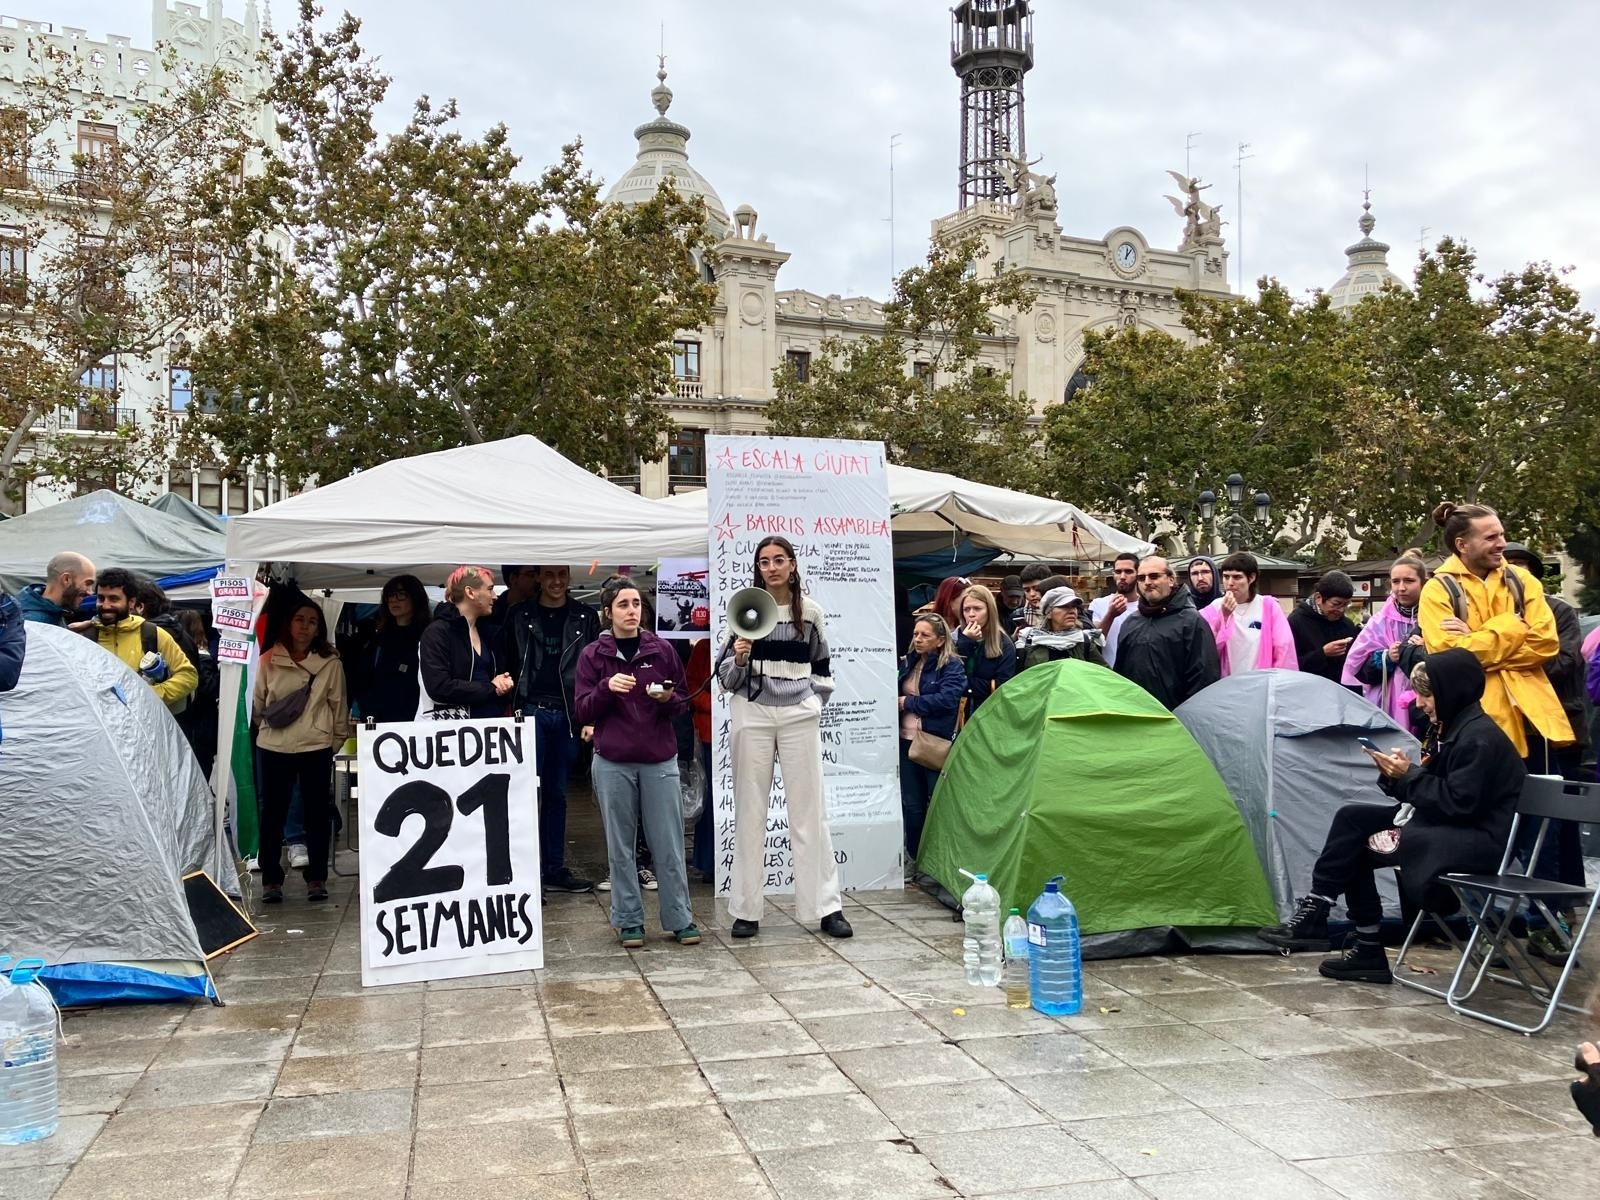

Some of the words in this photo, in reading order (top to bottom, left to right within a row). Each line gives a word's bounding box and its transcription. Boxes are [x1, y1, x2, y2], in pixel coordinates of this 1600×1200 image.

[742, 449, 804, 473] ESCALA
[746, 514, 804, 535] BARRIS
[813, 517, 890, 538] ASSAMBLEA
[735, 540, 760, 556] CIU
[791, 543, 821, 557] ELLA
[732, 560, 755, 575] EIX
[731, 577, 755, 590] EXT
[218, 588, 247, 596] GRATIS
[221, 608, 246, 618] PISOS
[217, 616, 247, 627] GRATIS
[820, 730, 842, 746] IMS
[373, 726, 524, 775] QUEDEN
[373, 773, 513, 904] 21
[376, 892, 533, 957] SETMANES
